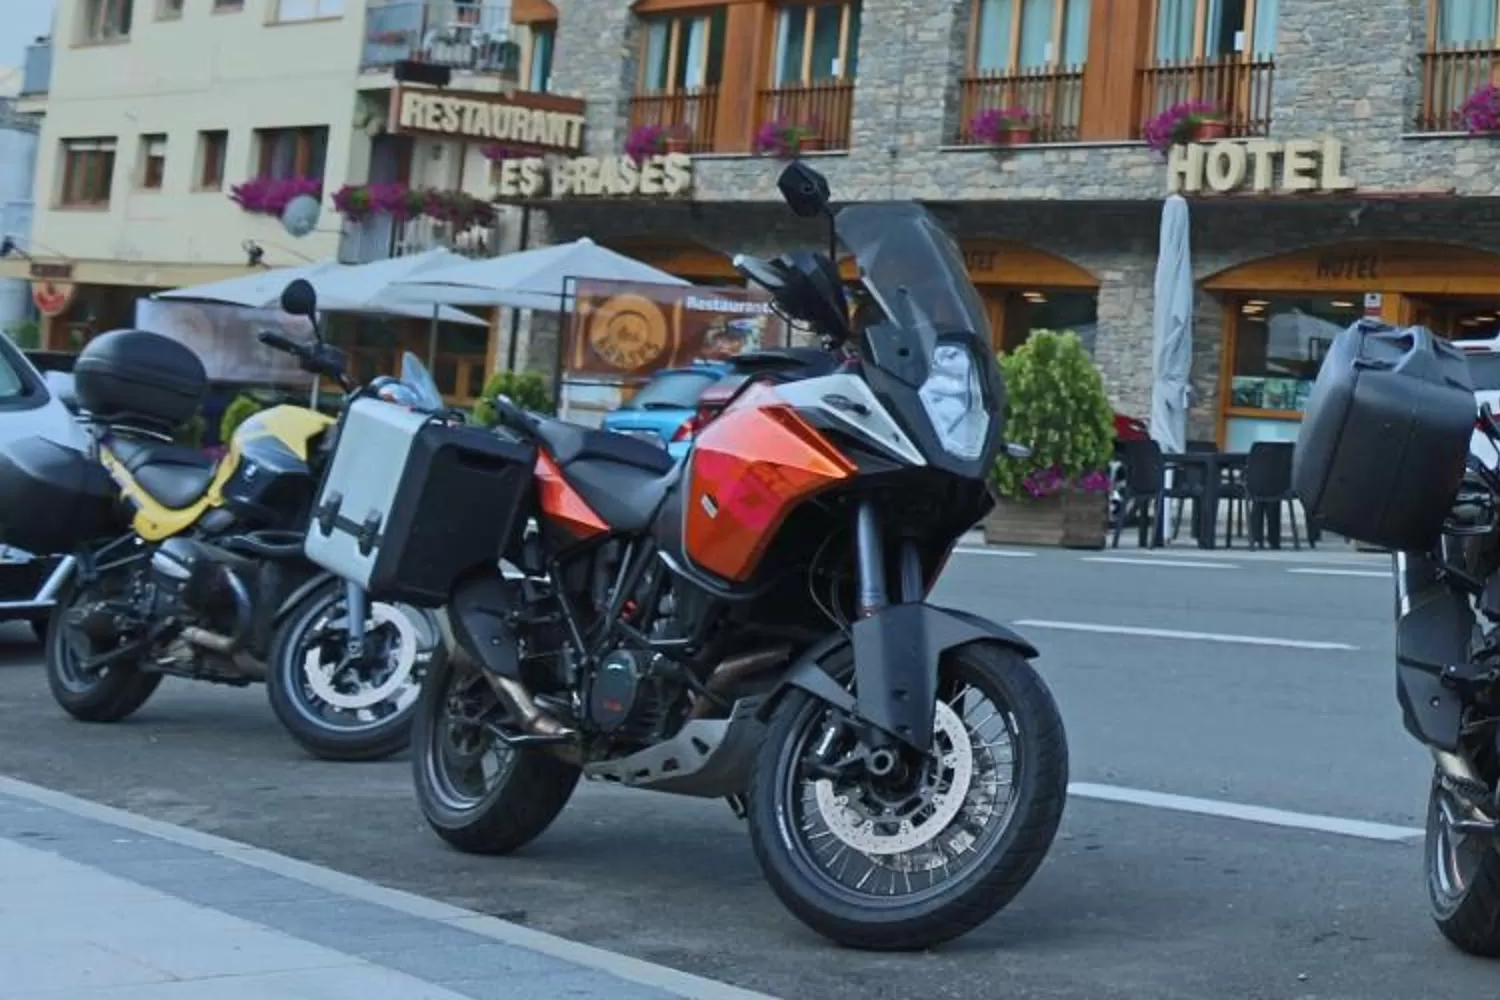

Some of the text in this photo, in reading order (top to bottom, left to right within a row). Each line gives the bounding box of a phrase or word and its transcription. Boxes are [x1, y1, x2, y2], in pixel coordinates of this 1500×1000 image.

[400, 91, 585, 149] RESTAURANT
[550, 152, 692, 200] BRASES
[1168, 138, 1355, 195] HOTEL
